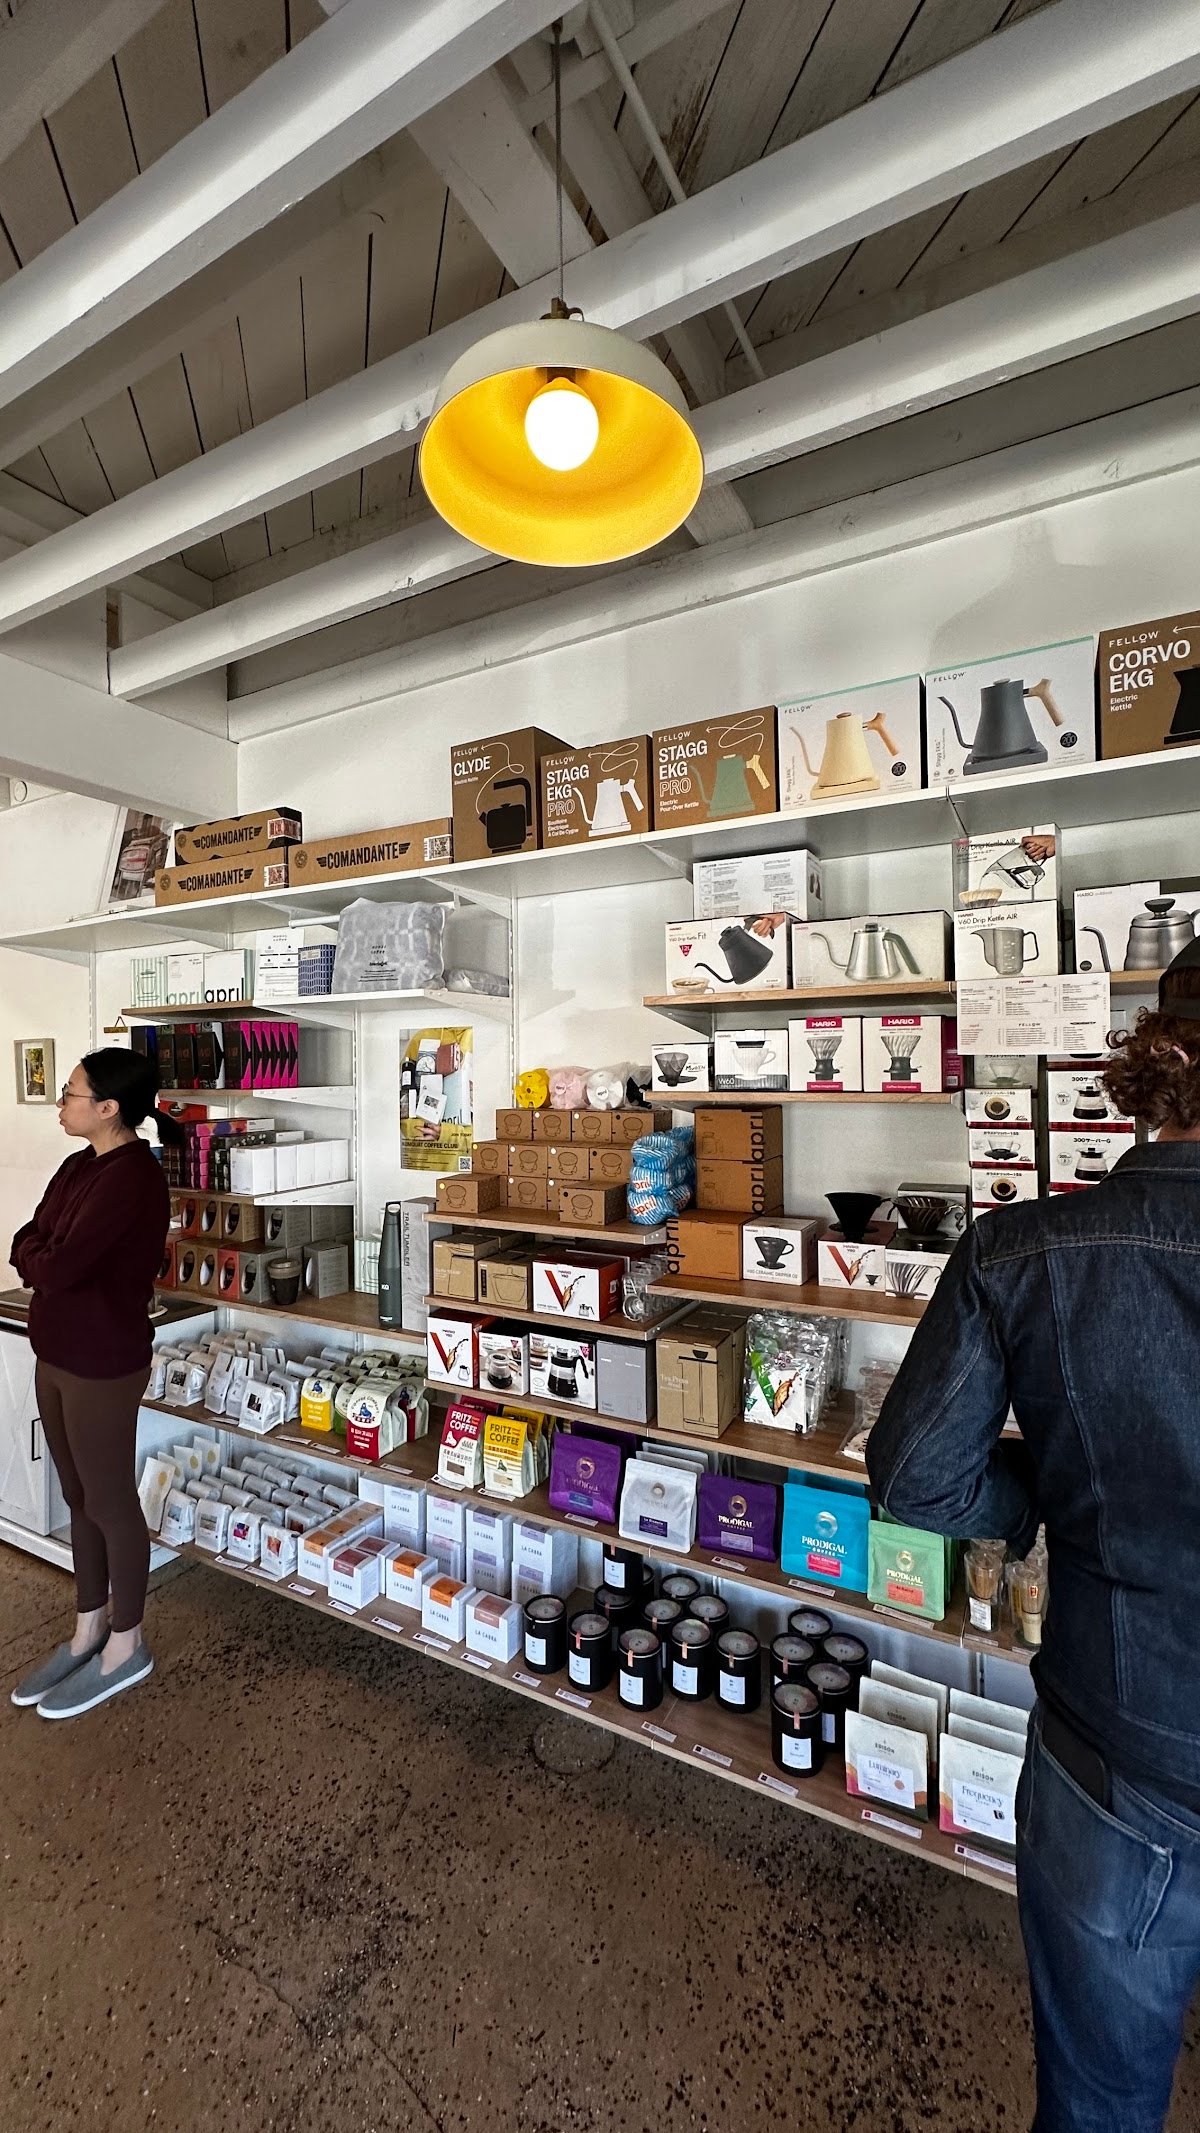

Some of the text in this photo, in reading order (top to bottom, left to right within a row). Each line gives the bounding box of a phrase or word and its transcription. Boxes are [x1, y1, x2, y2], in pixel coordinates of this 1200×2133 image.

[1109, 630, 1159, 647] FELLOW
[1109, 639, 1191, 673] CORVO
[933, 672, 965, 684] FELLOW
[1110, 667, 1155, 694] EKG
[1110, 694, 1138, 705] Electric
[1110, 702, 1132, 712] Kettle
[784, 704, 811, 714] FELLOW
[659, 731, 691, 743] FELLOW
[453, 747, 479, 757] FELLOW
[659, 740, 708, 763] STAGG
[453, 755, 492, 777] CLYDE
[546, 755, 575, 767] FELLOW
[546, 765, 590, 785] STAGG
[659, 761, 688, 780] EKG
[547, 784, 573, 801] EKG
[660, 778, 692, 797] PRO
[548, 799, 575, 817] PRO
[660, 799, 678, 807] Electric
[200, 827, 255, 850] COMANDANTE
[326, 842, 399, 869] COMANDANTE
[186, 868, 244, 891] COMANDANTE
[972, 917, 986, 925] Drip
[987, 914, 1005, 922] Kettle
[204, 977, 245, 1003] april
[742, 1109, 765, 1161] april
[742, 1161, 766, 1215] april
[632, 1195, 657, 1216] april
[666, 1219, 686, 1275] april
[451, 1411, 472, 1423] FRITZ
[449, 1420, 477, 1435] COFFEE
[490, 1423, 512, 1435] FRITZ
[490, 1433, 519, 1446] COFFEE
[718, 1515, 754, 1528] PRODIGAL
[801, 1535, 846, 1554] PRODIGAL
[886, 1569, 923, 1584] PRODIGAL
[436, 1612, 449, 1622] CABRA
[482, 1632, 497, 1642] CABRA
[874, 1742, 895, 1754] EDISON
[972, 1770, 994, 1782] EDISON
[962, 1785, 1004, 1808] Frequency
